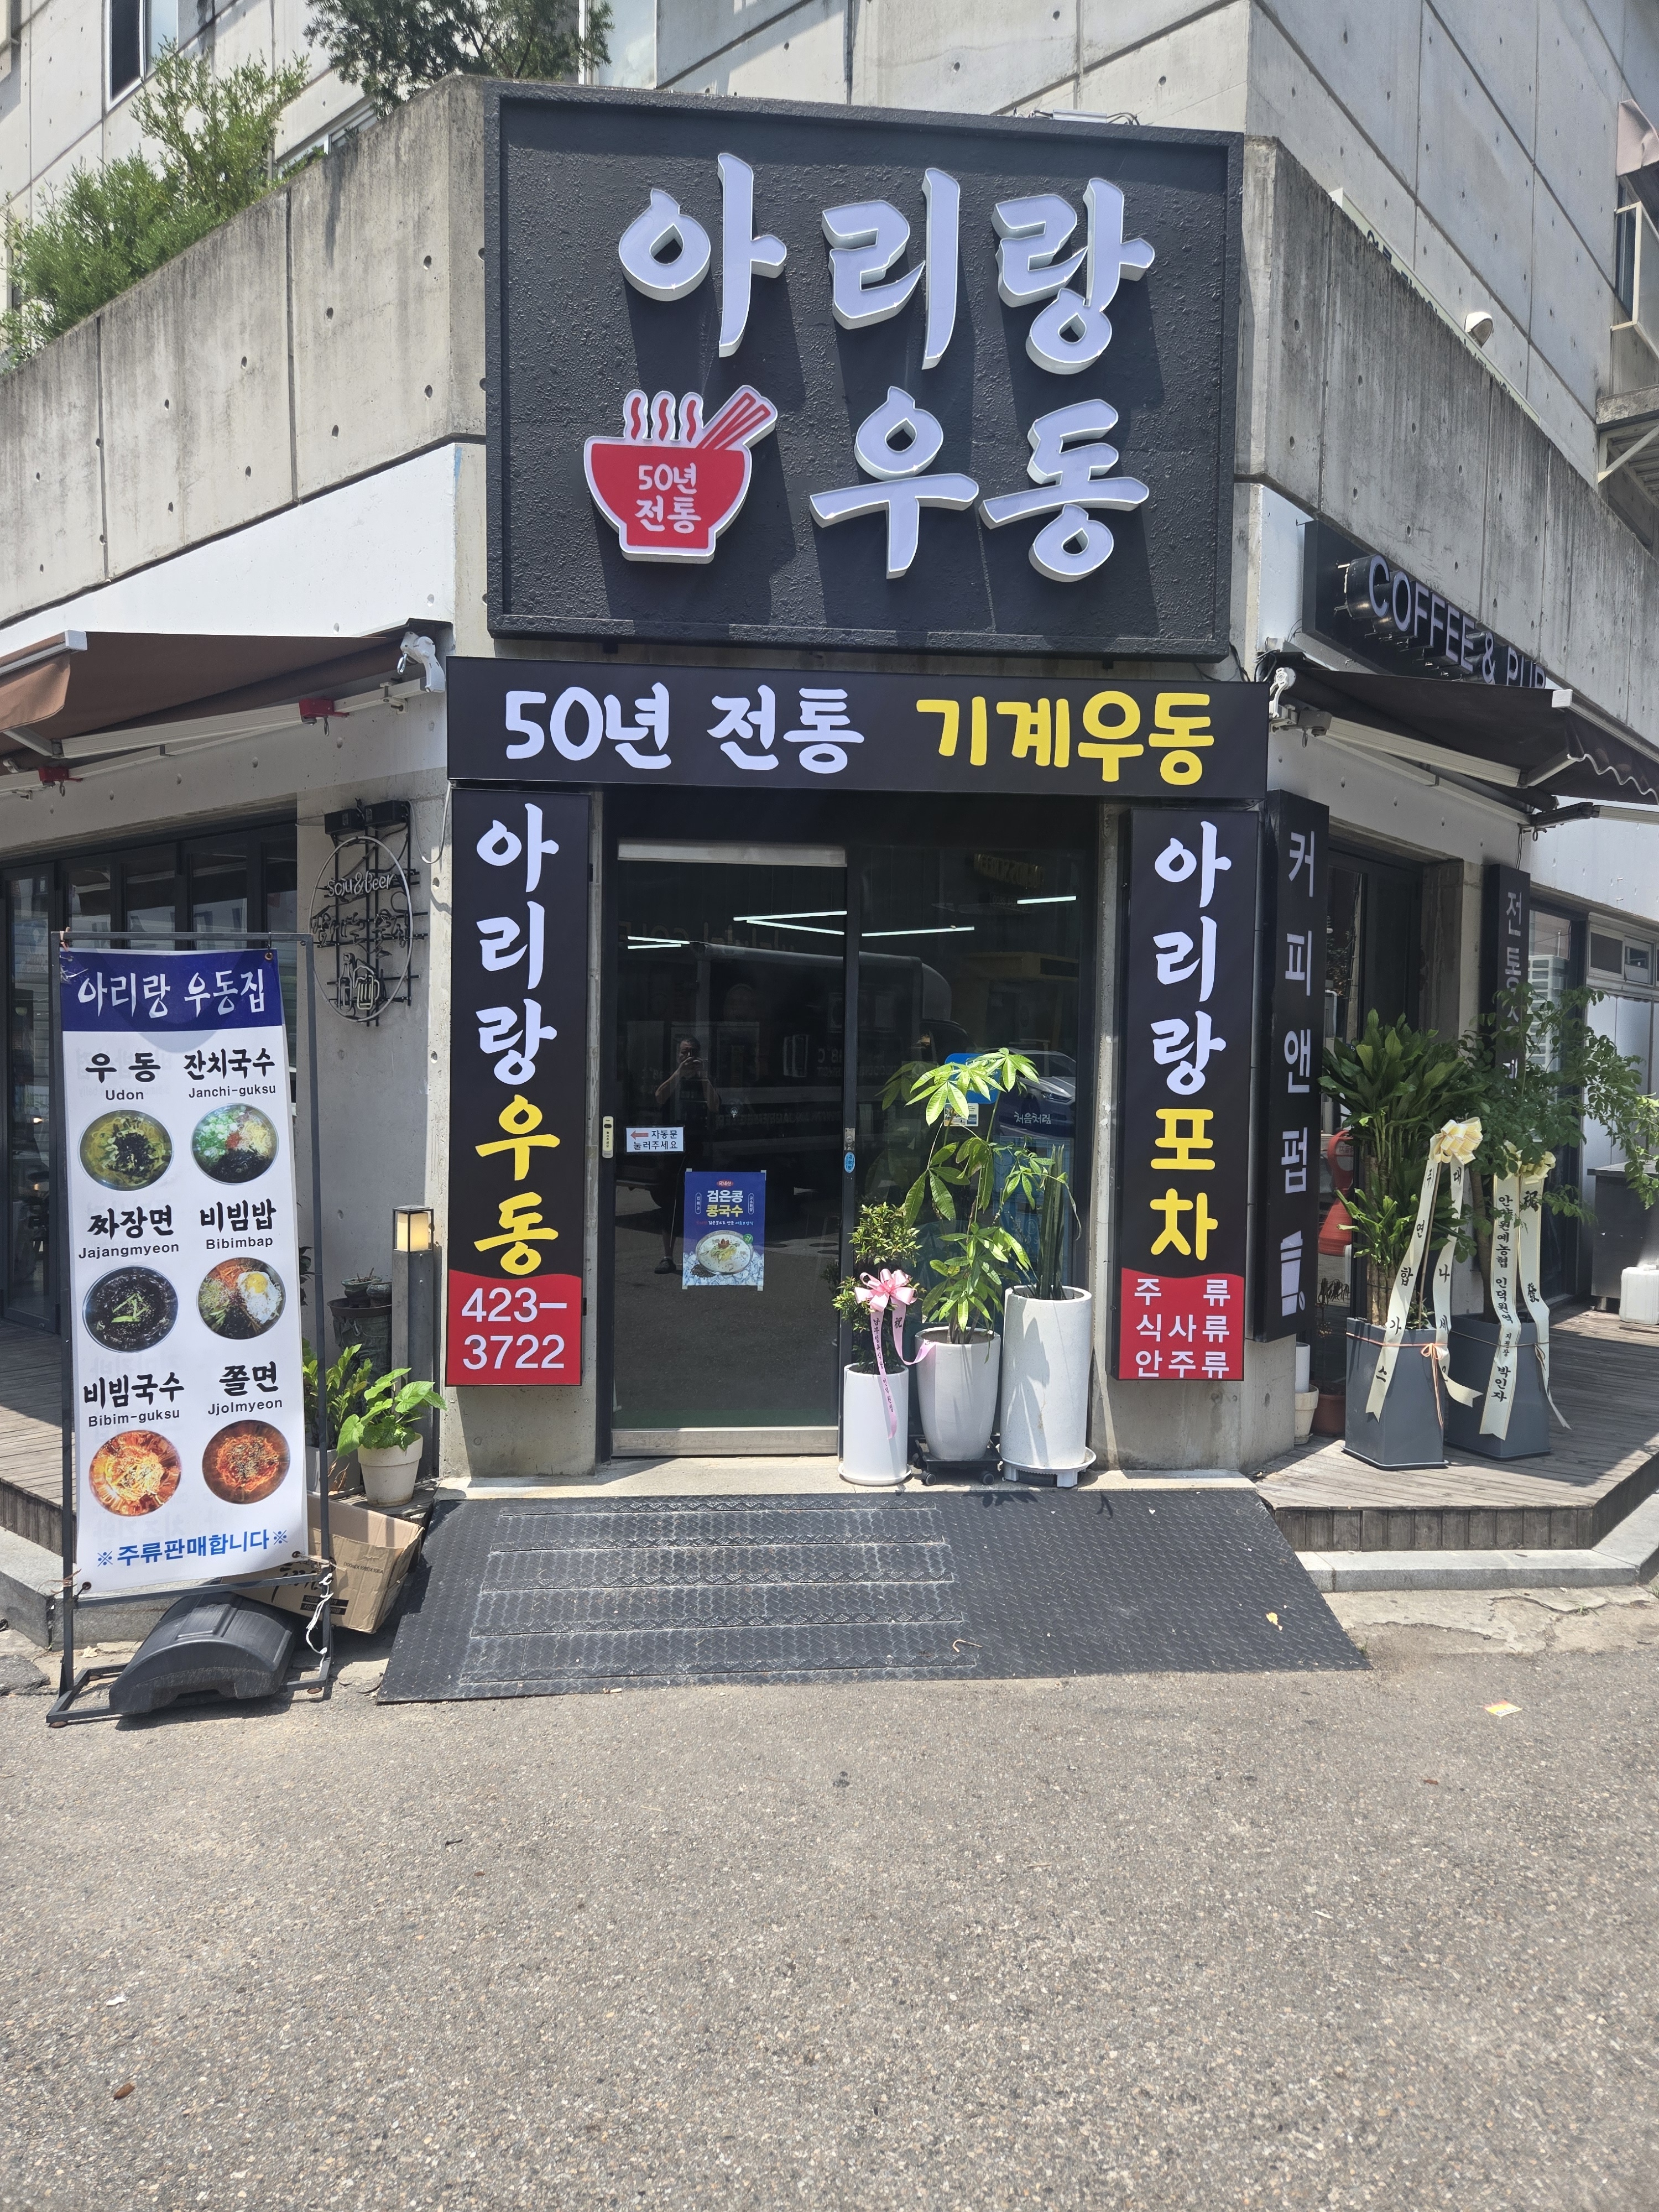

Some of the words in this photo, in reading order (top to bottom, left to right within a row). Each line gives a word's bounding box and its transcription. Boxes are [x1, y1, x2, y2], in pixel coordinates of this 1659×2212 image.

[618, 153, 1156, 375] 아리랑
[638, 462, 698, 497] 50년
[810, 387, 1150, 583] 우동
[634, 498, 702, 534] 전통
[1368, 554, 1475, 672] COFFEE
[505, 682, 672, 771] 50년
[707, 684, 864, 775] 전통
[916, 690, 1214, 786] 기계우동
[77, 971, 170, 1018] 아리랑
[184, 969, 265, 1018] 우동집
[184, 1047, 275, 1081] 잔치국수
[105, 1089, 144, 1100] Udon
[189, 1084, 276, 1099] Janchi-guksu
[1013, 1111, 1052, 1125] 처음처럼
[633, 1140, 678, 1150] 눌러주세요
[651, 1130, 678, 1139] 자동문
[706, 1204, 744, 1218] 콩국수
[707, 1190, 744, 1203] 검은콩
[87, 1204, 174, 1240] 짜장면
[200, 1198, 277, 1233] 비빔밥
[78, 1243, 180, 1260] Jajangmyeon
[206, 1237, 274, 1250] Bibimbap
[1136, 1314, 1230, 1343] 식사류
[462, 1334, 565, 1370] 3722
[1135, 1349, 1230, 1379] 안주류
[83, 1371, 185, 1410] 비빔국수
[218, 1361, 279, 1397] 쫄면
[88, 1408, 180, 1427] Bibim-guksu
[207, 1398, 283, 1416] Jjolmyeon
